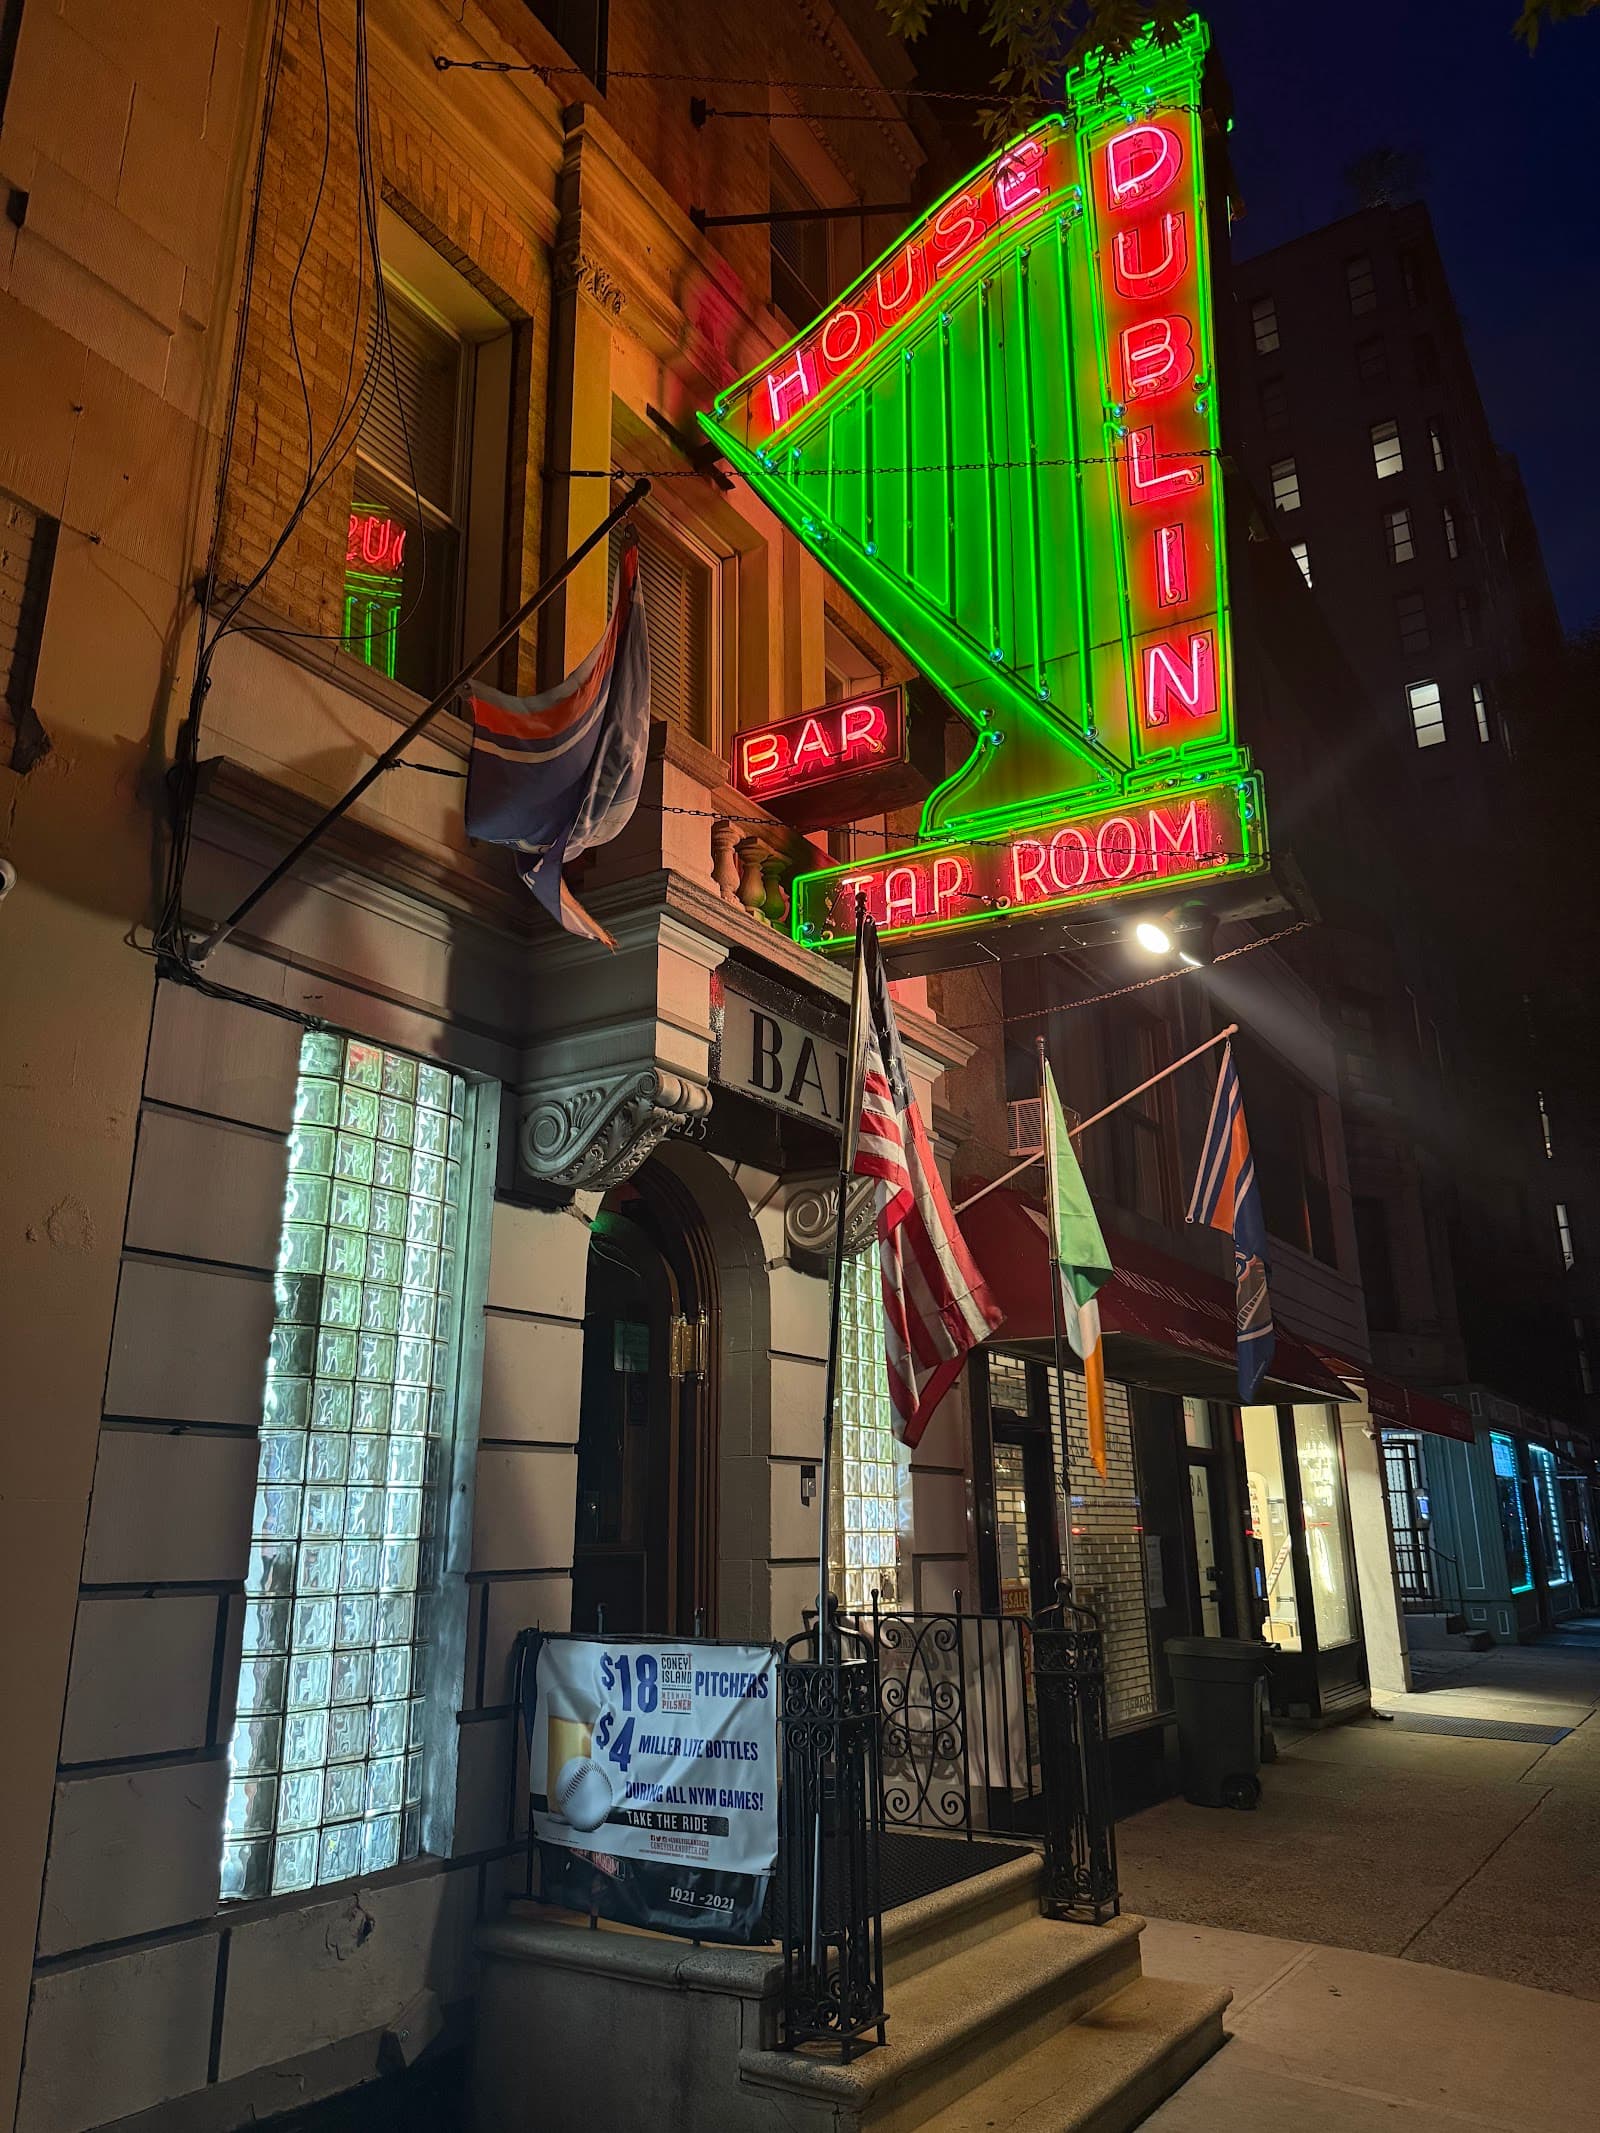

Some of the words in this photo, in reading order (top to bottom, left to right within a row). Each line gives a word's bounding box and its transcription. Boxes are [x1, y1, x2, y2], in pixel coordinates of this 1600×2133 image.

[767, 140, 1050, 431] HOUSE
[1105, 126, 1217, 729] DUBLIN
[741, 704, 888, 788] BAR
[842, 856, 973, 928] TAP
[1011, 800, 1214, 902] ROOM
[748, 1008, 848, 1122] BA
[661, 1656, 689, 1670] CONEY
[662, 1670, 692, 1684] ISLAND
[600, 1652, 658, 1713] $18
[695, 1670, 769, 1699] PITCHERS
[662, 1700, 692, 1711] PILSNER
[596, 1712, 636, 1772] $4
[638, 1735, 682, 1757] MILLER
[683, 1738, 705, 1758] LITE
[705, 1740, 759, 1761] BOTTLES
[625, 1781, 664, 1803] DURING
[666, 1785, 687, 1804] ALL
[689, 1787, 717, 1807] NYM
[719, 1789, 764, 1811] GAMES!
[626, 1811, 653, 1827] TAKE
[656, 1813, 678, 1829] THE
[682, 1815, 709, 1832] RIDE
[670, 1886, 695, 1903] 1921
